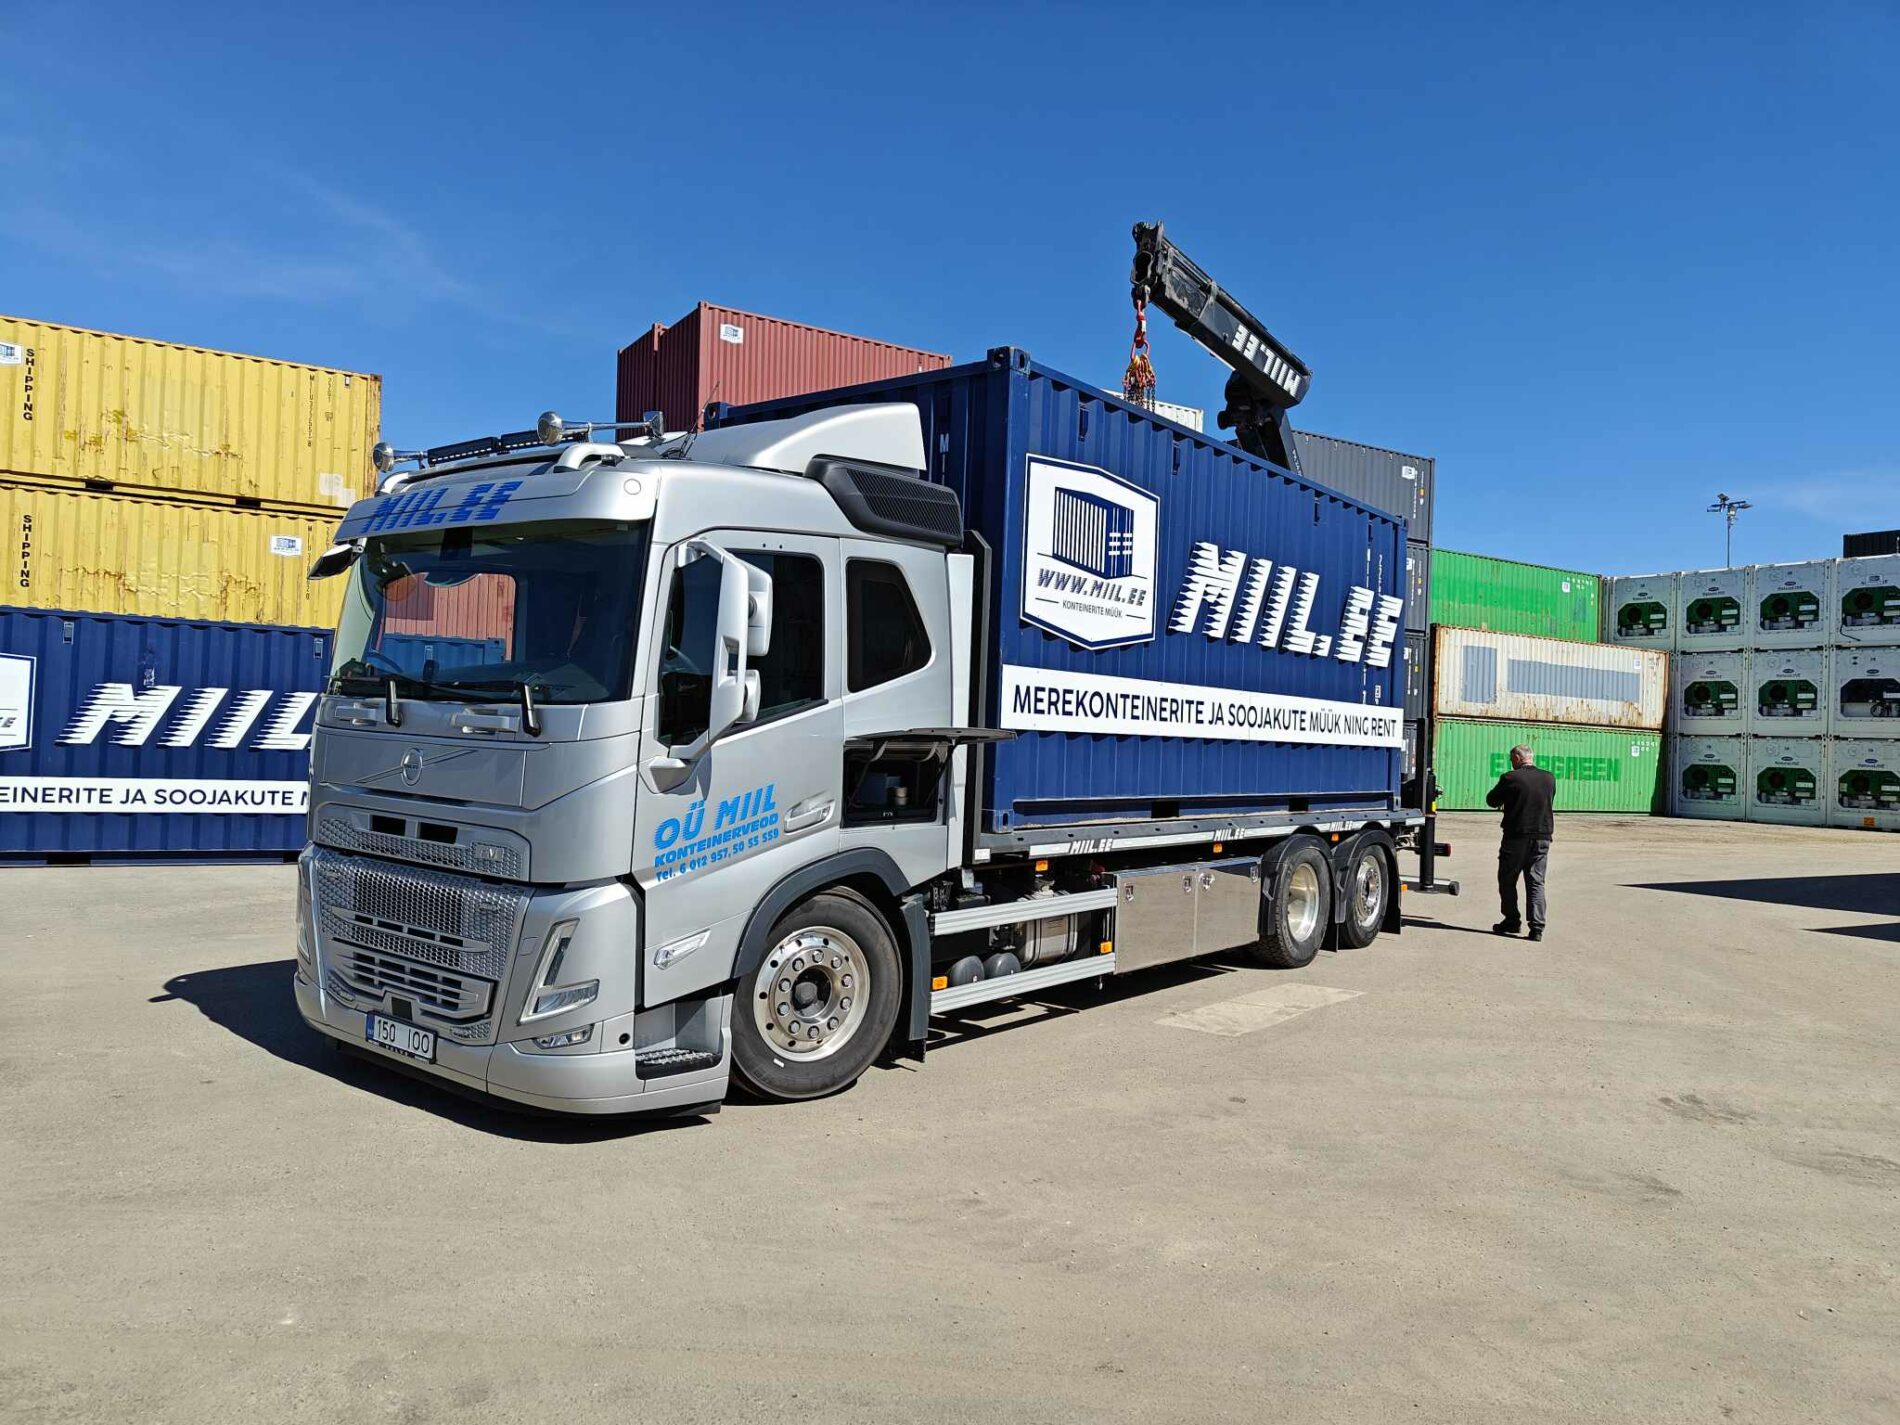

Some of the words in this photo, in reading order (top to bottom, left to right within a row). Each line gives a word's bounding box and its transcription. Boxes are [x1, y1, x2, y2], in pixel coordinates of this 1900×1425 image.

[23, 348, 35, 420] SHIPPING
[361, 480, 524, 533] MIIL.EE
[20, 514, 32, 587] SHIPPING
[1037, 568, 1147, 606] WWW.MIIL.EE
[1062, 600, 1104, 615] KONTEINERITE
[1105, 606, 1123, 618] MÜÜK
[1168, 541, 1403, 667] MIIL.EE
[1013, 684, 1204, 724] MEREKONTEINERITE
[1208, 702, 1224, 726] JA
[1228, 703, 1306, 731] SOOJAKUTE
[1309, 708, 1341, 734] MÜÜK
[1344, 715, 1369, 736] NING
[1371, 718, 1396, 737] RENT
[1490, 753, 1620, 781] ERGREEN
[120, 789, 146, 804] JA
[154, 789, 294, 806] SOOJAKUTE
[654, 800, 705, 851] OÜ
[714, 784, 777, 831] MIIL
[655, 812, 779, 868] KONTEINERVEOD
[656, 870, 676, 882] Tel.
[679, 863, 687, 874] 6
[690, 858, 707, 871] 012
[733, 843, 745, 856] 50
[748, 836, 759, 849] 55
[762, 828, 779, 843] 559
[1070, 838, 1113, 854] MIIL.EE
[1213, 827, 1246, 842] MIIL.EE
[378, 1019, 396, 1043] 150
